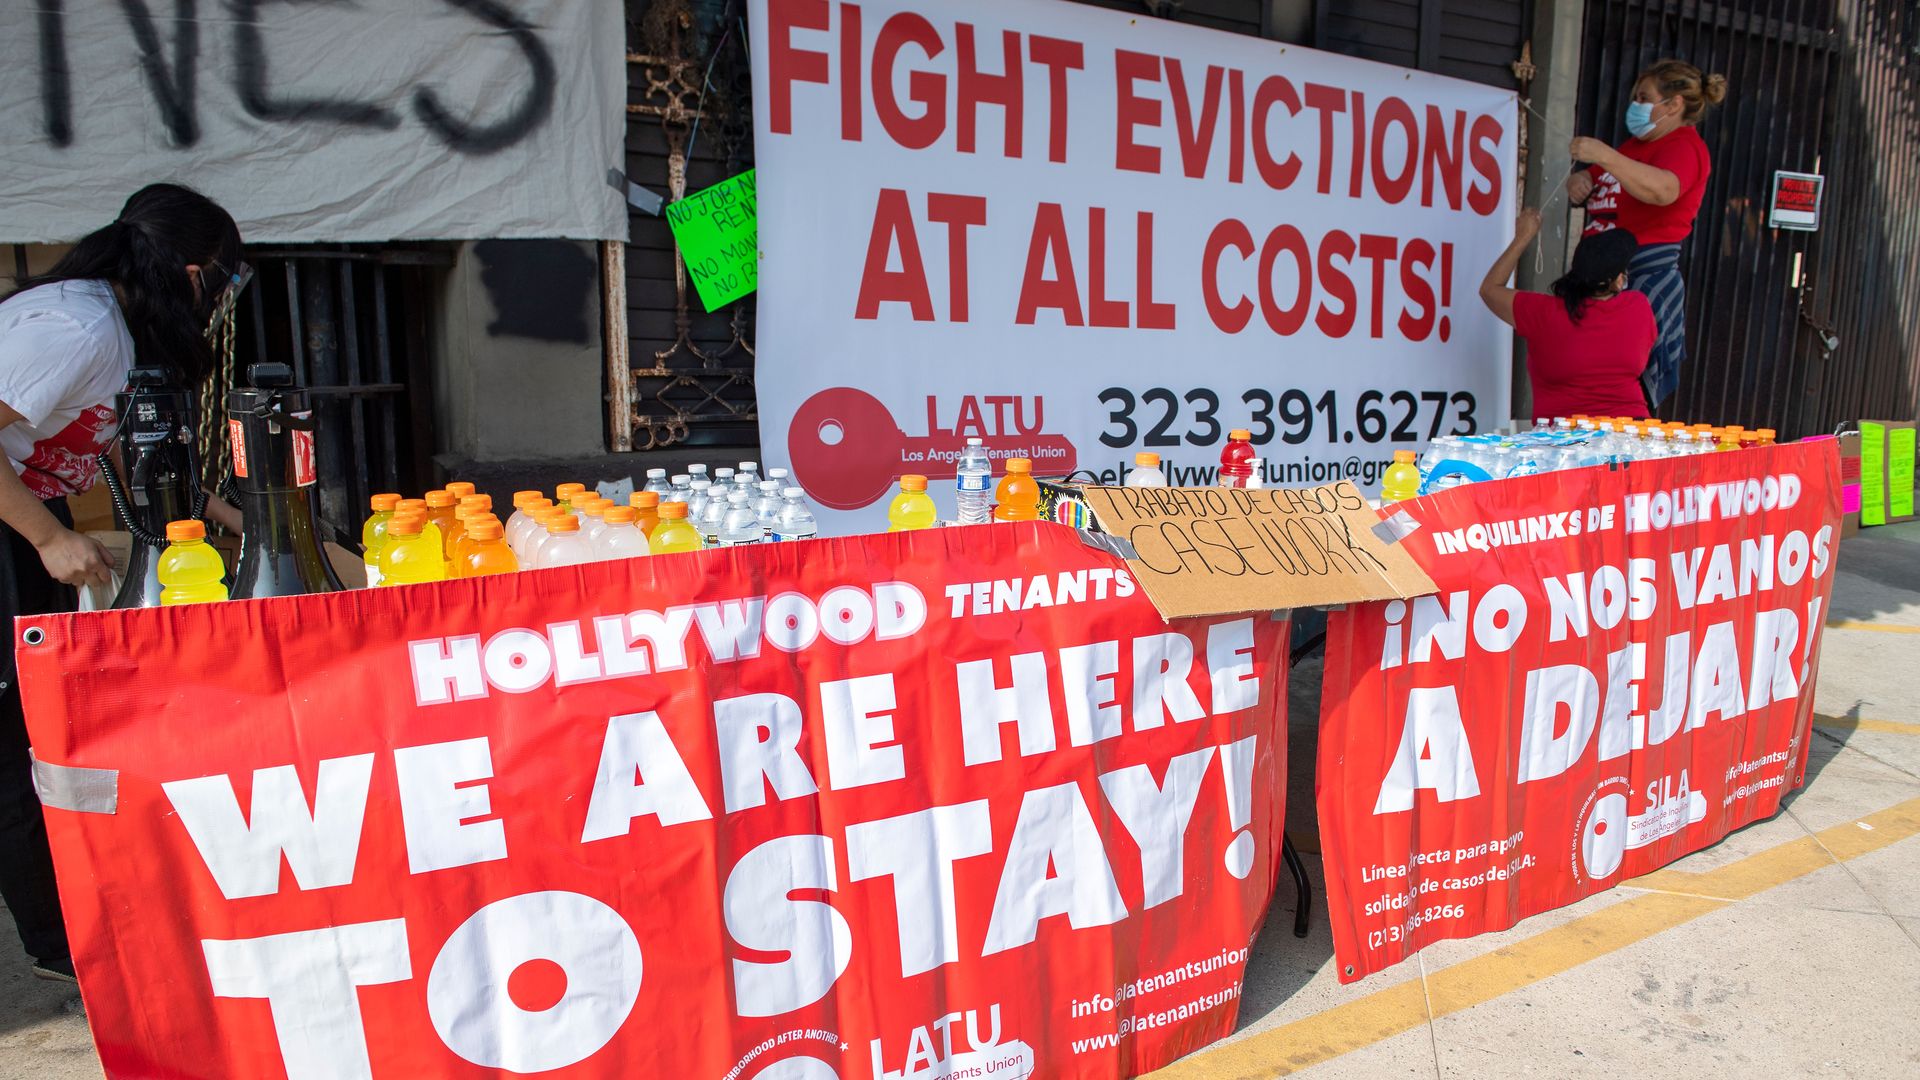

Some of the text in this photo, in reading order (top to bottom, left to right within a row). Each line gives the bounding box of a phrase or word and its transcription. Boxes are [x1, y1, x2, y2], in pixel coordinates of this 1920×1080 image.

[768, 0, 1504, 216] FIGHT EVICTIONS
[667, 201, 692, 228] NO
[690, 182, 736, 217] JOB
[711, 192, 757, 233] REN
[692, 256, 719, 285] NO
[714, 272, 738, 297] NO
[855, 188, 1454, 343] AT ALL COSTS!
[927, 395, 1043, 437] LATU
[901, 448, 924, 462] Los
[1032, 445, 1066, 458] Union
[1087, 482, 1362, 520] TRABAJO DE CASOS
[1432, 510, 1583, 555] INQUILINXS
[1587, 504, 1616, 533] DE
[1623, 473, 1802, 535] HOLLYWOOD
[408, 567, 1136, 706] HOLLYWOOD TENANTS
[1380, 584, 1528, 671] ¡NO
[1543, 558, 1657, 642] NOS
[1373, 596, 1823, 815] A DEJAR!
[161, 617, 1260, 900] WE ARE HERE
[1646, 768, 1690, 809] SILA
[1362, 864, 1407, 883] Línea
[1455, 842, 1487, 864] para
[1489, 830, 1524, 855] apoyo
[1420, 877, 1439, 895] de
[1442, 873, 1485, 890] casos
[1486, 866, 1510, 882] del
[1510, 853, 1537, 877] SILA:
[201, 735, 1257, 1080] TO STAY!
[1368, 925, 1405, 950] (213)
[1071, 946, 1249, 1018] info@latenantsunion
[722, 1029, 839, 1080] GHBORHOOD AFTER ANOTHER
[870, 1003, 1001, 1080] LATU
[986, 1054, 1024, 1074] Union
